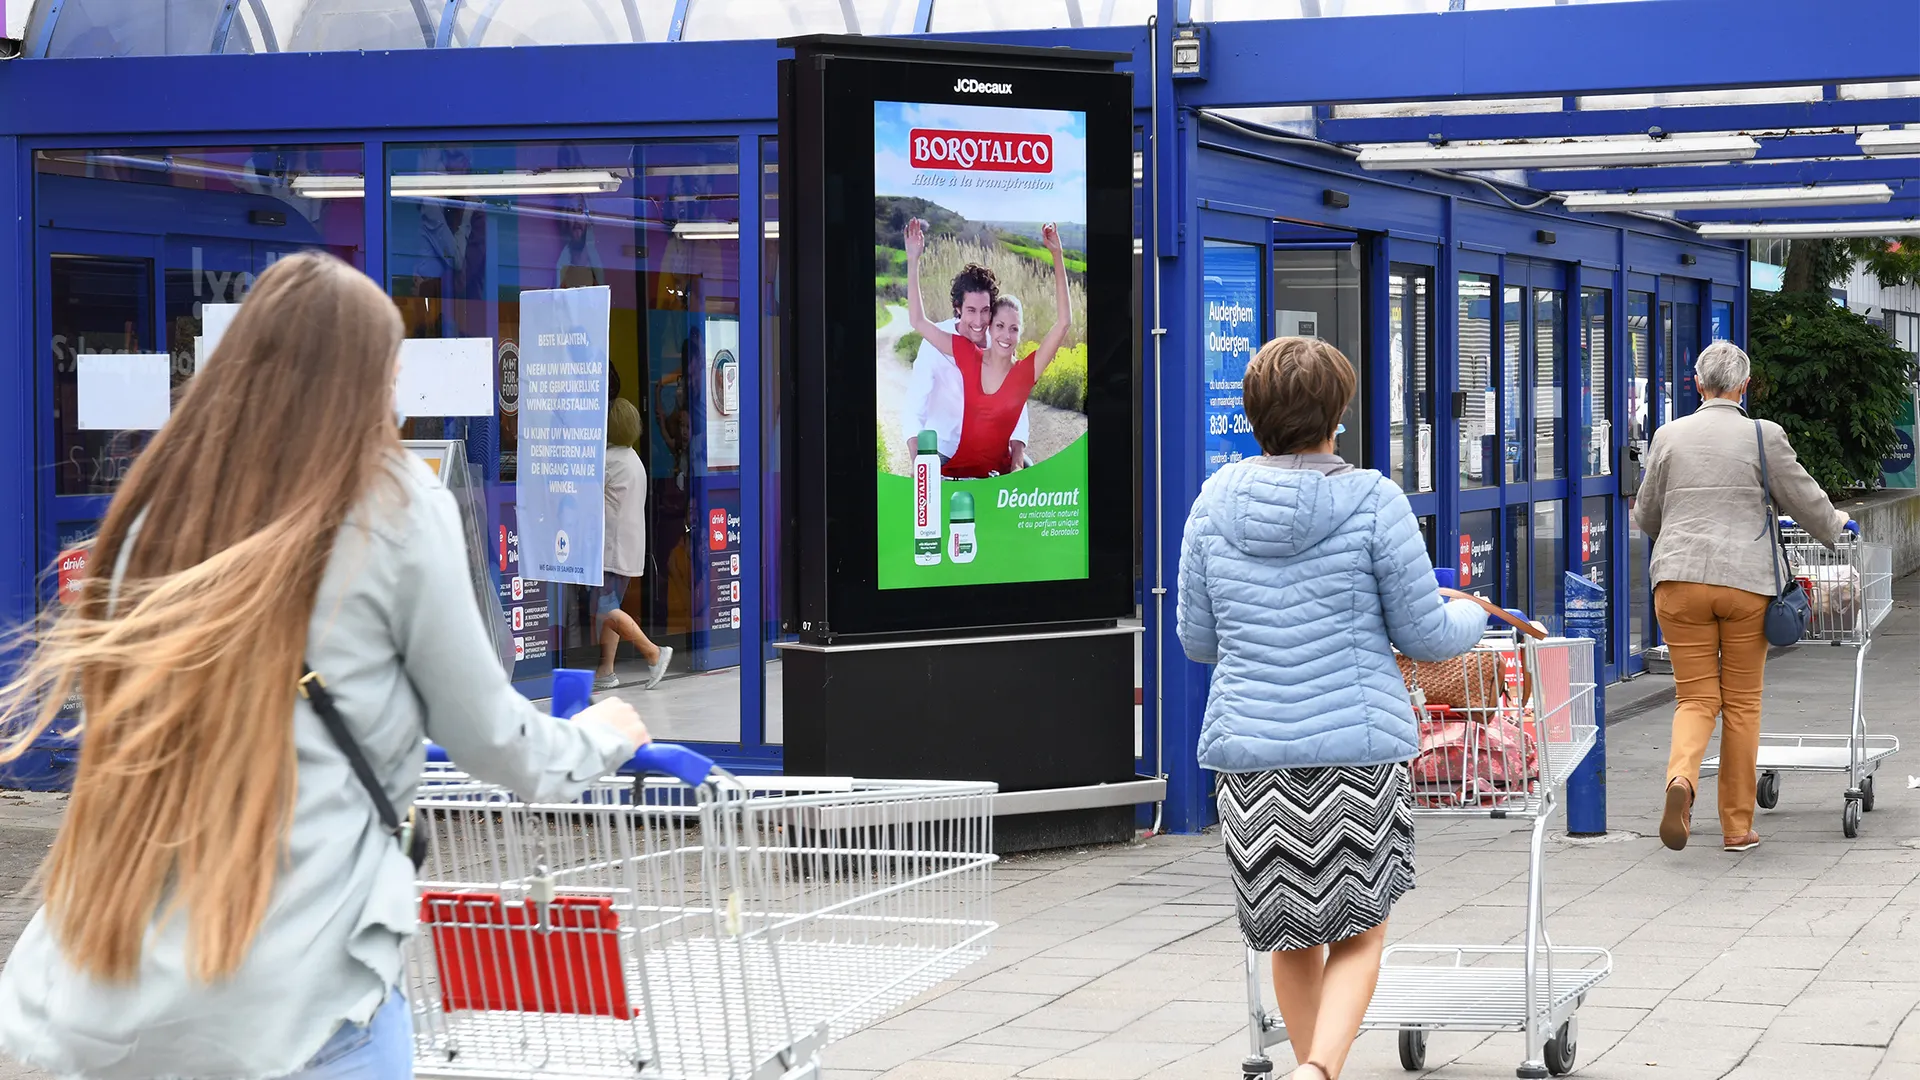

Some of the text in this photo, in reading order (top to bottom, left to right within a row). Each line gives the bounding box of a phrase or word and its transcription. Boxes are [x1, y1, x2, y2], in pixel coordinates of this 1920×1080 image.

[953, 78, 1013, 95] JCDecaux
[914, 136, 1049, 169] BOROTALCO
[912, 173, 946, 186] Halte
[960, 174, 973, 187] la
[975, 177, 1054, 191] transpiration
[1209, 300, 1253, 328] Auderghem
[538, 332, 590, 347] BESTE KLANTEN,
[1209, 331, 1250, 358] Oudergem
[526, 362, 603, 376] NEEM UW WINKELKAR
[503, 371, 516, 383] FOR
[502, 384, 518, 397] FOOD
[528, 379, 600, 393] IN DE GEBRUIKELIJKE
[526, 397, 601, 411] WINKELKARSTALLING.
[1210, 414, 1228, 435] 8:30
[523, 427, 603, 441] U KUNT UW WINKELKAR
[530, 445, 596, 458] DESINFECTEREN AAN
[531, 462, 596, 477] DE INGANG VAN DE
[549, 480, 578, 494] WINKEL.
[918, 465, 927, 526] BOROTALCO
[996, 487, 1080, 509] Déodorant
[711, 513, 725, 525] drive
[1028, 510, 1056, 519] microtalc
[1057, 509, 1080, 517] naturel
[1034, 519, 1057, 529] parfum
[1057, 519, 1080, 528] unique
[1041, 528, 1080, 537] de Borotalco
[63, 556, 86, 571] drive
[539, 563, 546, 571] WE
[802, 621, 812, 631] 07
